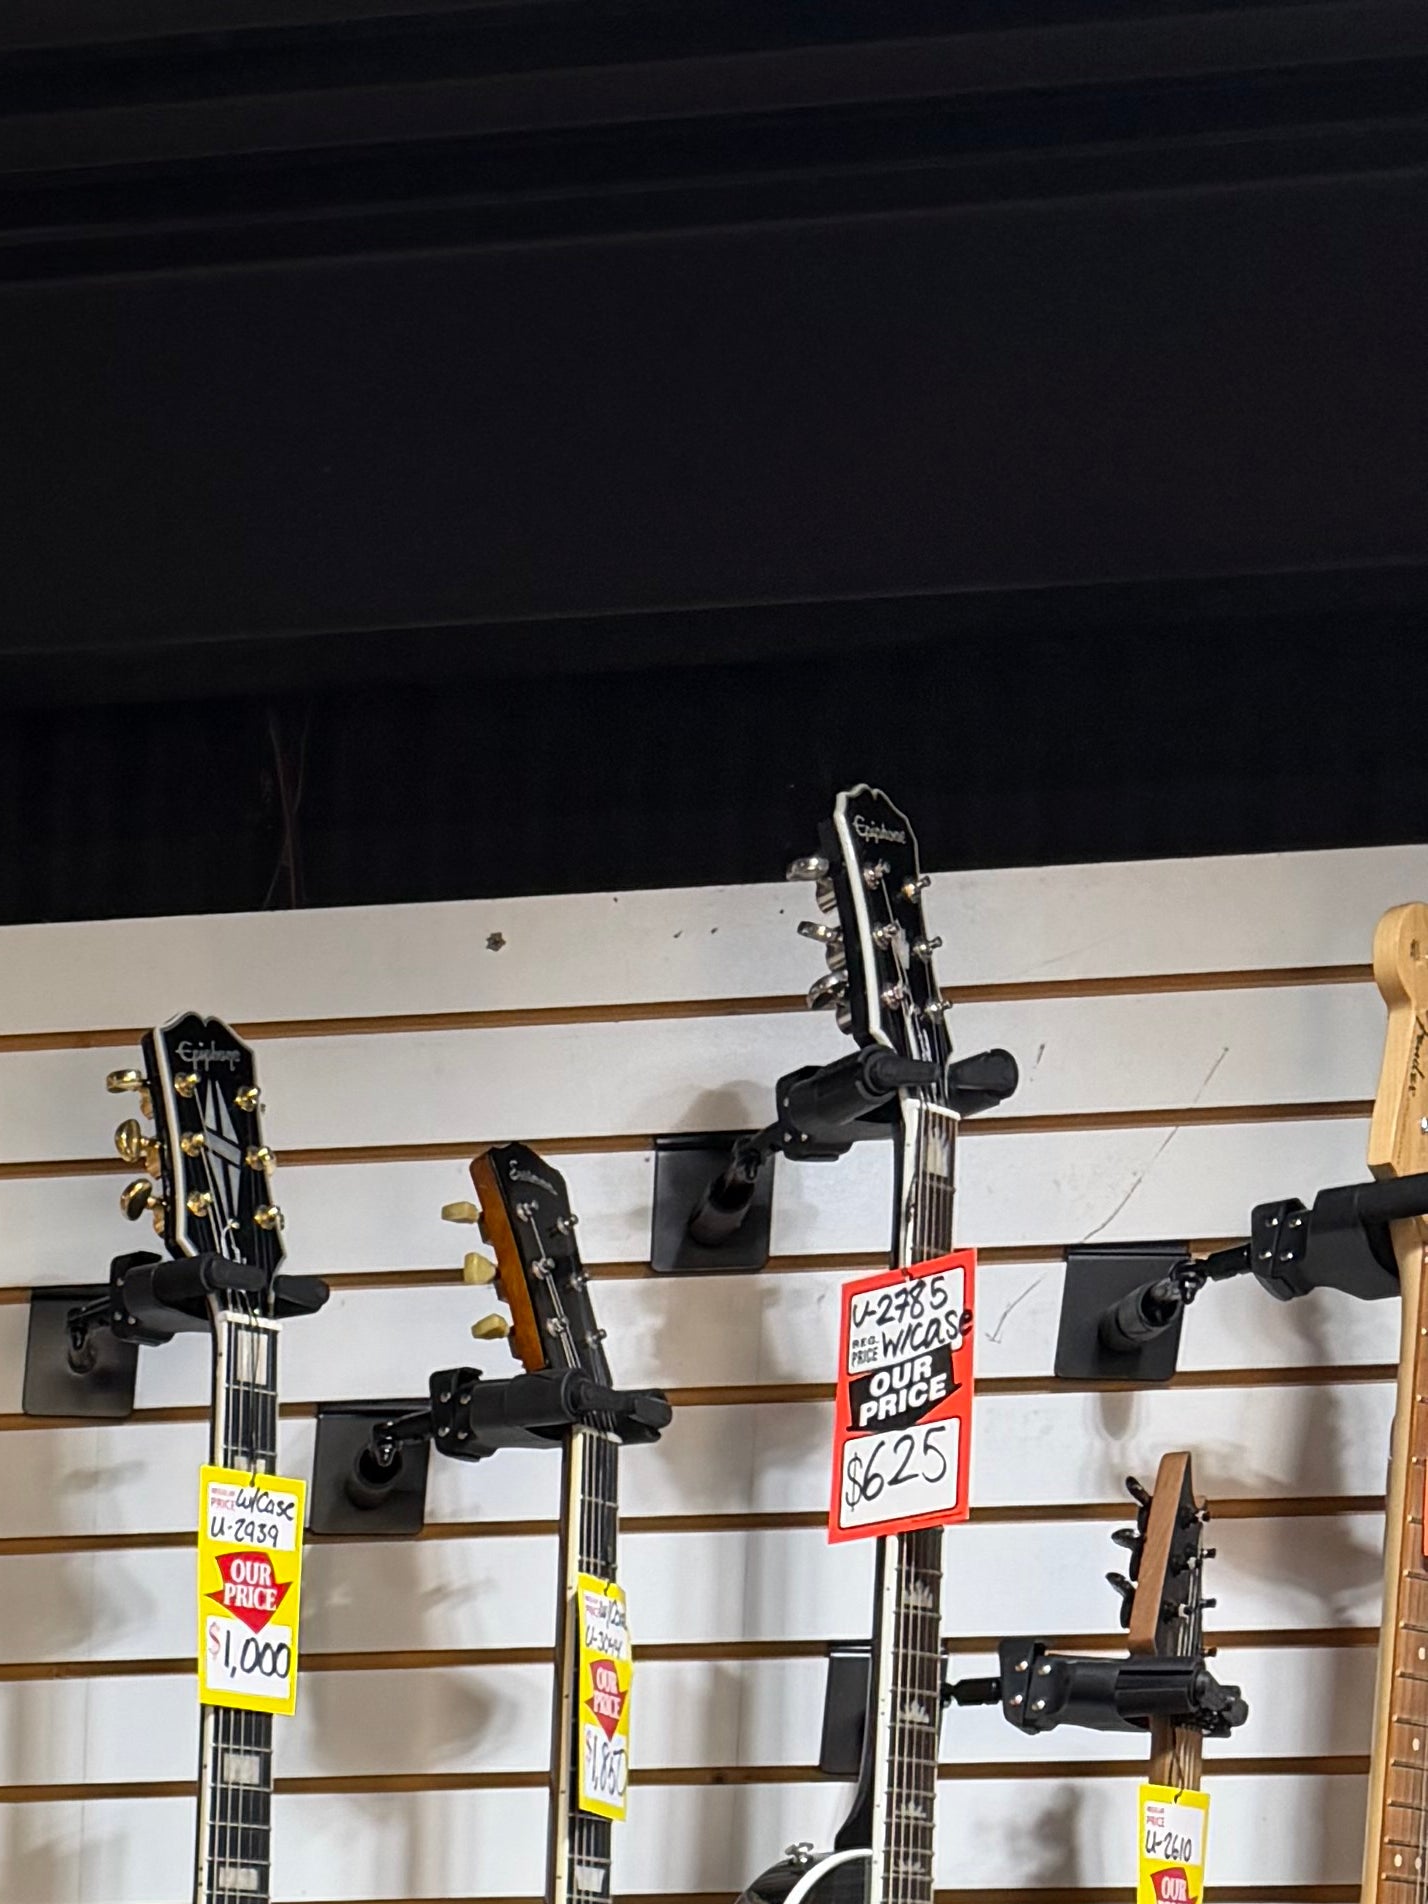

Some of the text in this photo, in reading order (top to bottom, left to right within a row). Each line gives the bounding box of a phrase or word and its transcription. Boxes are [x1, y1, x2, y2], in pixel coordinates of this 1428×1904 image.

[851, 813, 907, 845] Epiphone
[176, 1039, 243, 1070] Epiphone
[851, 1348, 879, 1368] PRICE
[868, 1355, 934, 1397] OUR
[858, 1373, 948, 1428] PRICE
[845, 1426, 948, 1512] $625
[209, 1515, 280, 1548] U-2939
[229, 1558, 273, 1587] OUR
[223, 1582, 279, 1612] PRICE
[207, 1620, 292, 1680] $1,000
[595, 1666, 619, 1693] OUR
[592, 1691, 623, 1721] PRICE
[1144, 1829, 1193, 1863] U-2610
[1160, 1876, 1188, 1902] OUR
